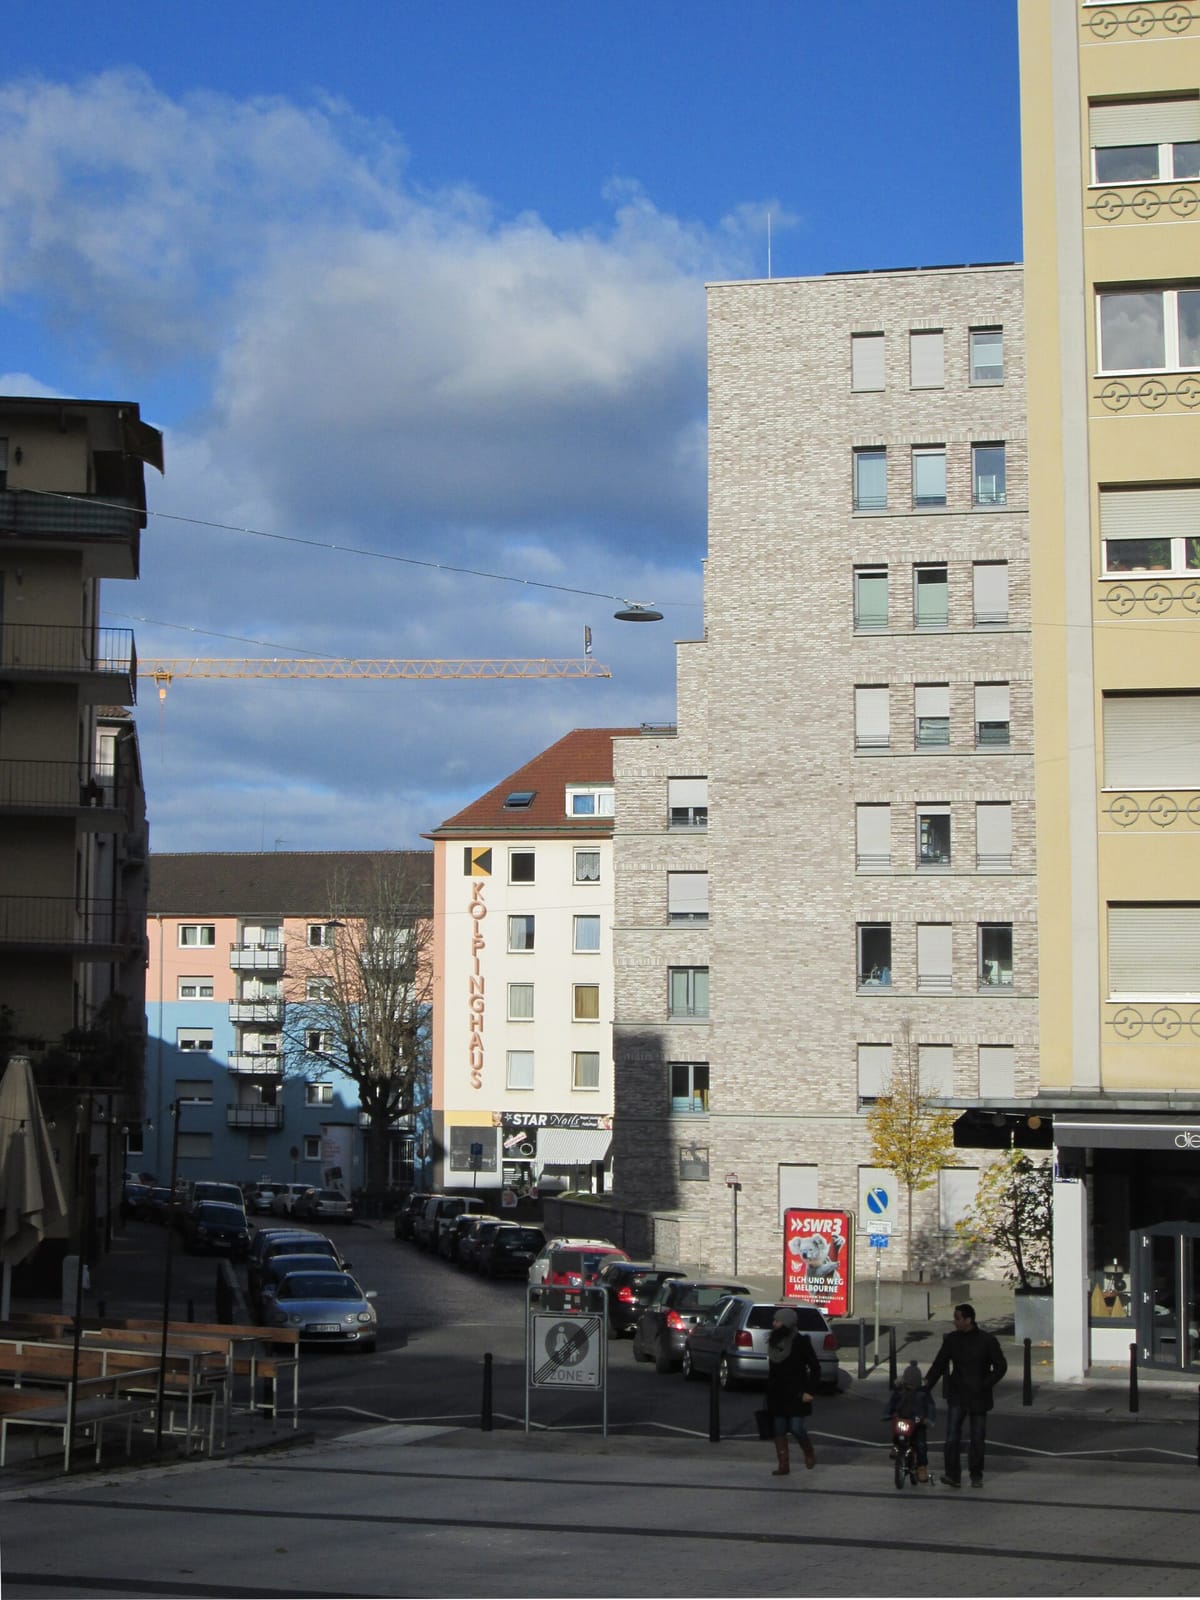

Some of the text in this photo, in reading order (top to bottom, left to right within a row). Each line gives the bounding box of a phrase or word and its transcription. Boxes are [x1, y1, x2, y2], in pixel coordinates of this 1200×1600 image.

[469, 881, 487, 1089] KOLPINGHAUS
[512, 1113, 548, 1126] STAR
[550, 1114, 580, 1125] Nails
[789, 1276, 844, 1286] ELCH UND WEG
[794, 1284, 839, 1293] MELBOURNE
[550, 1369, 583, 1382] ZONE
